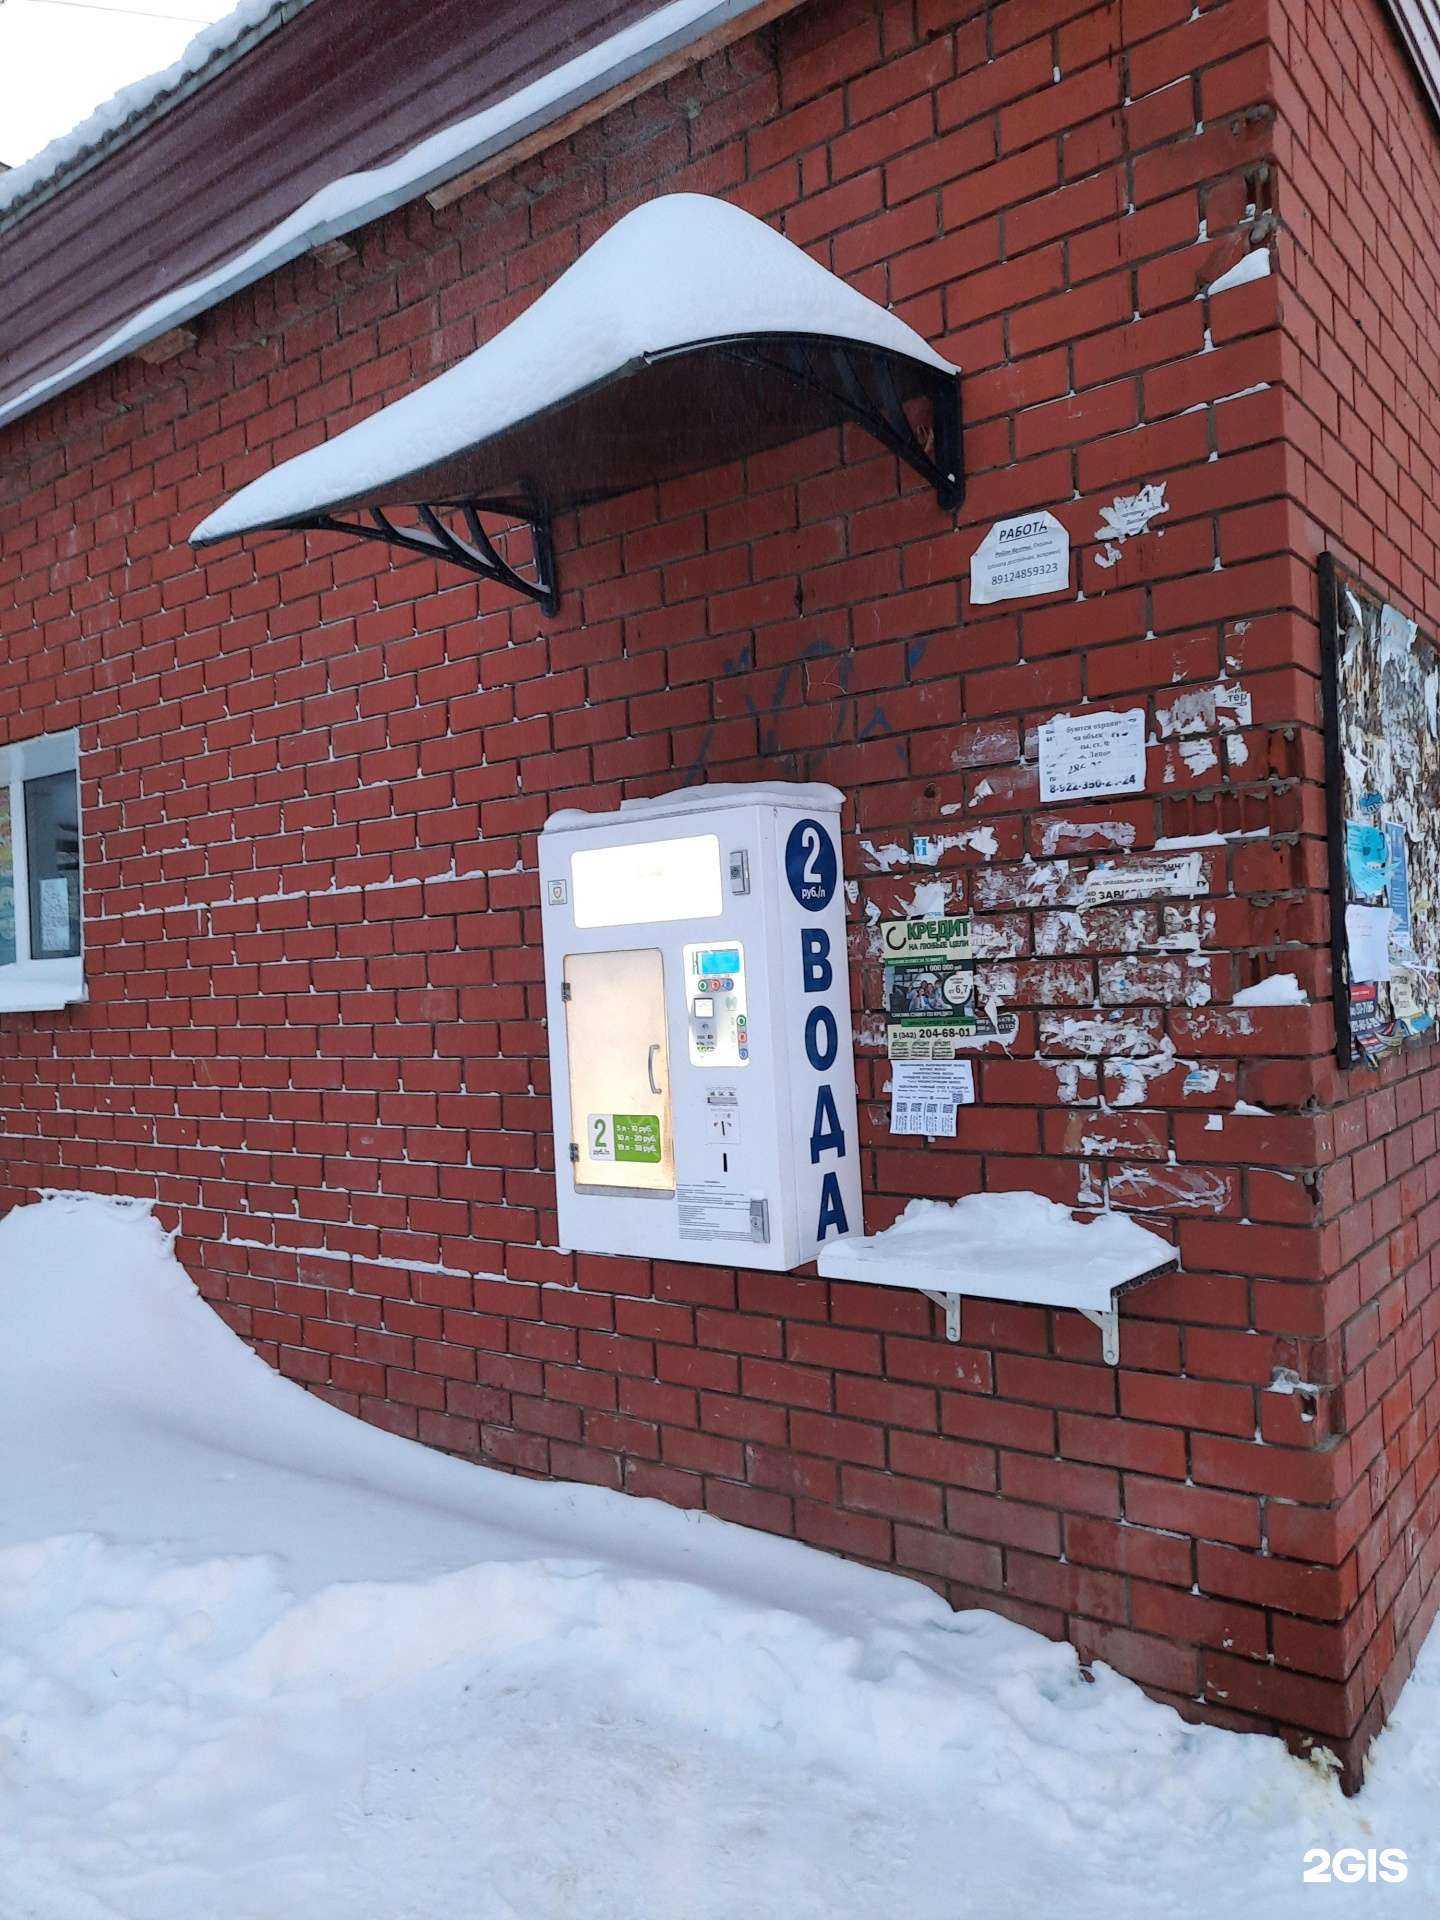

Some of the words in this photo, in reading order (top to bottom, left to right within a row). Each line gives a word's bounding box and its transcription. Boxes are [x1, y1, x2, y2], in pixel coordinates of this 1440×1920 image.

[999, 520, 1047, 541] РАБОТА
[991, 562, 1058, 585] 89124859323
[802, 827, 821, 883] 2
[907, 917, 970, 941] КРЕДИТ
[949, 940, 969, 948] ЦЕЛИ
[898, 1032, 917, 1040] (342)
[919, 1027, 970, 1039] 204-68-01
[800, 928, 849, 1241] ВОДА
[594, 1118, 607, 1147] 2
